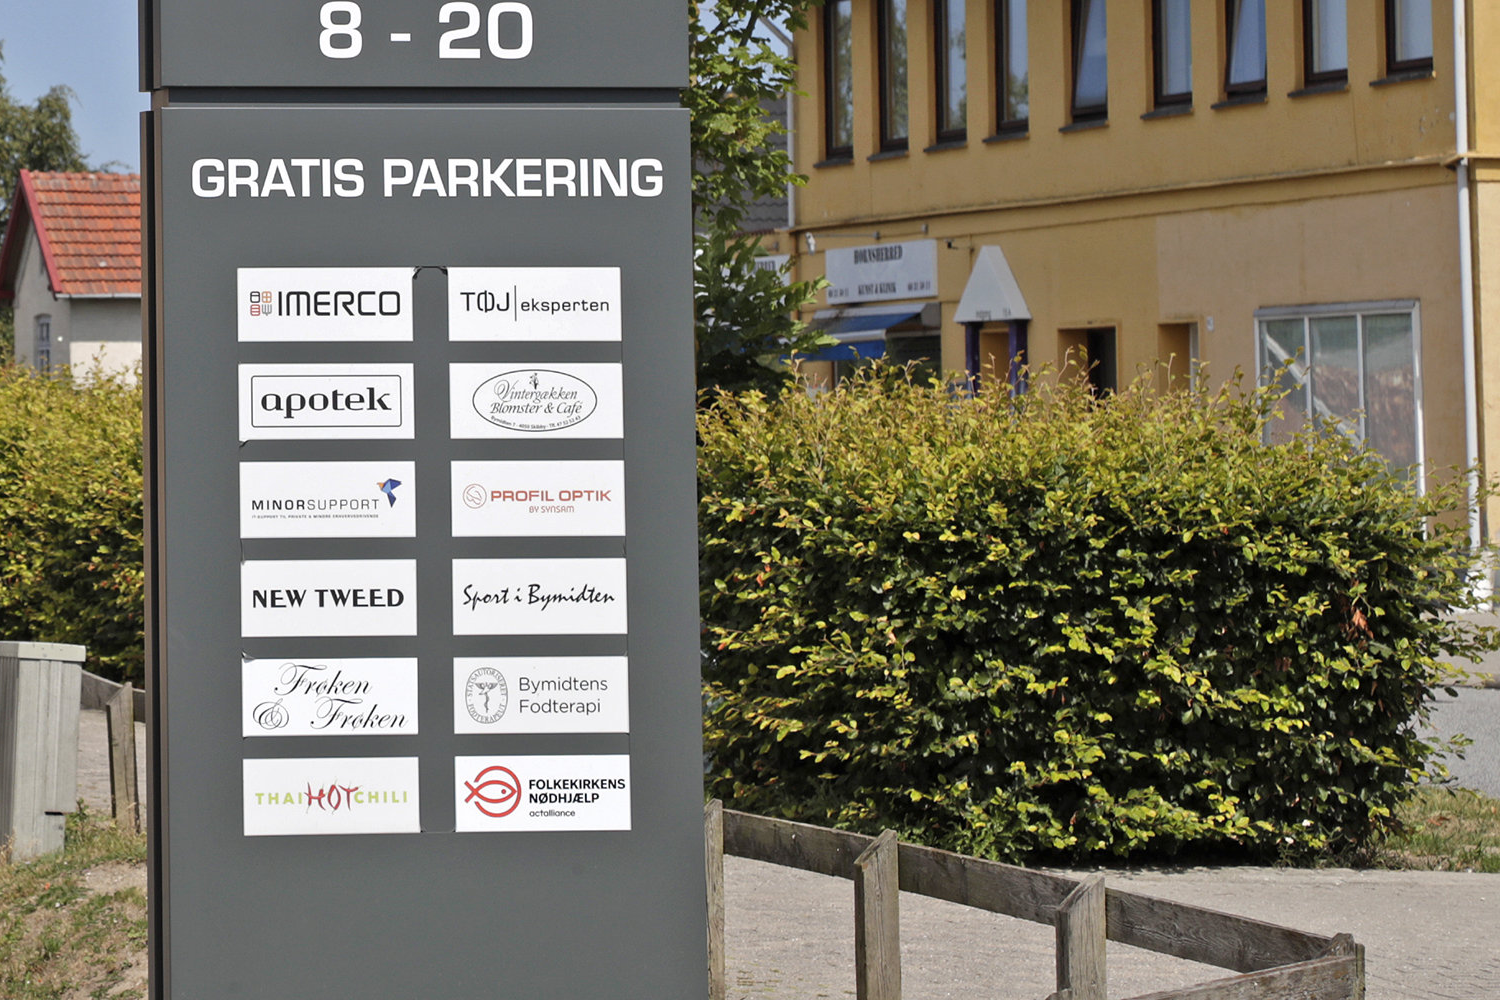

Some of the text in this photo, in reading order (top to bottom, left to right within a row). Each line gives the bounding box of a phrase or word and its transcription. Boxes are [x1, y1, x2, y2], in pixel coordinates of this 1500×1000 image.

[319, 1, 363, 59] 8
[438, 2, 534, 59] 20
[191, 158, 664, 198] GRATIS PARKERING
[278, 291, 400, 316] IMERCO
[493, 379, 578, 403] Vintergækken
[261, 387, 392, 419] apotek
[490, 400, 583, 418] Blomster & Café
[252, 499, 379, 510] MINORSUPPORT
[491, 490, 612, 502] PROFIL OPTIK
[529, 505, 539, 513] BY
[253, 588, 404, 608] NEW TWEED
[463, 584, 615, 611] Sport i Bymidten
[274, 662, 372, 697] Frøken
[519, 676, 608, 694] Bymidtens
[252, 696, 408, 730] & Frøken
[519, 698, 601, 716] Fodterapi
[529, 779, 626, 790] FOLKEKIRKENS
[529, 792, 600, 804] NØDHJÆLP
